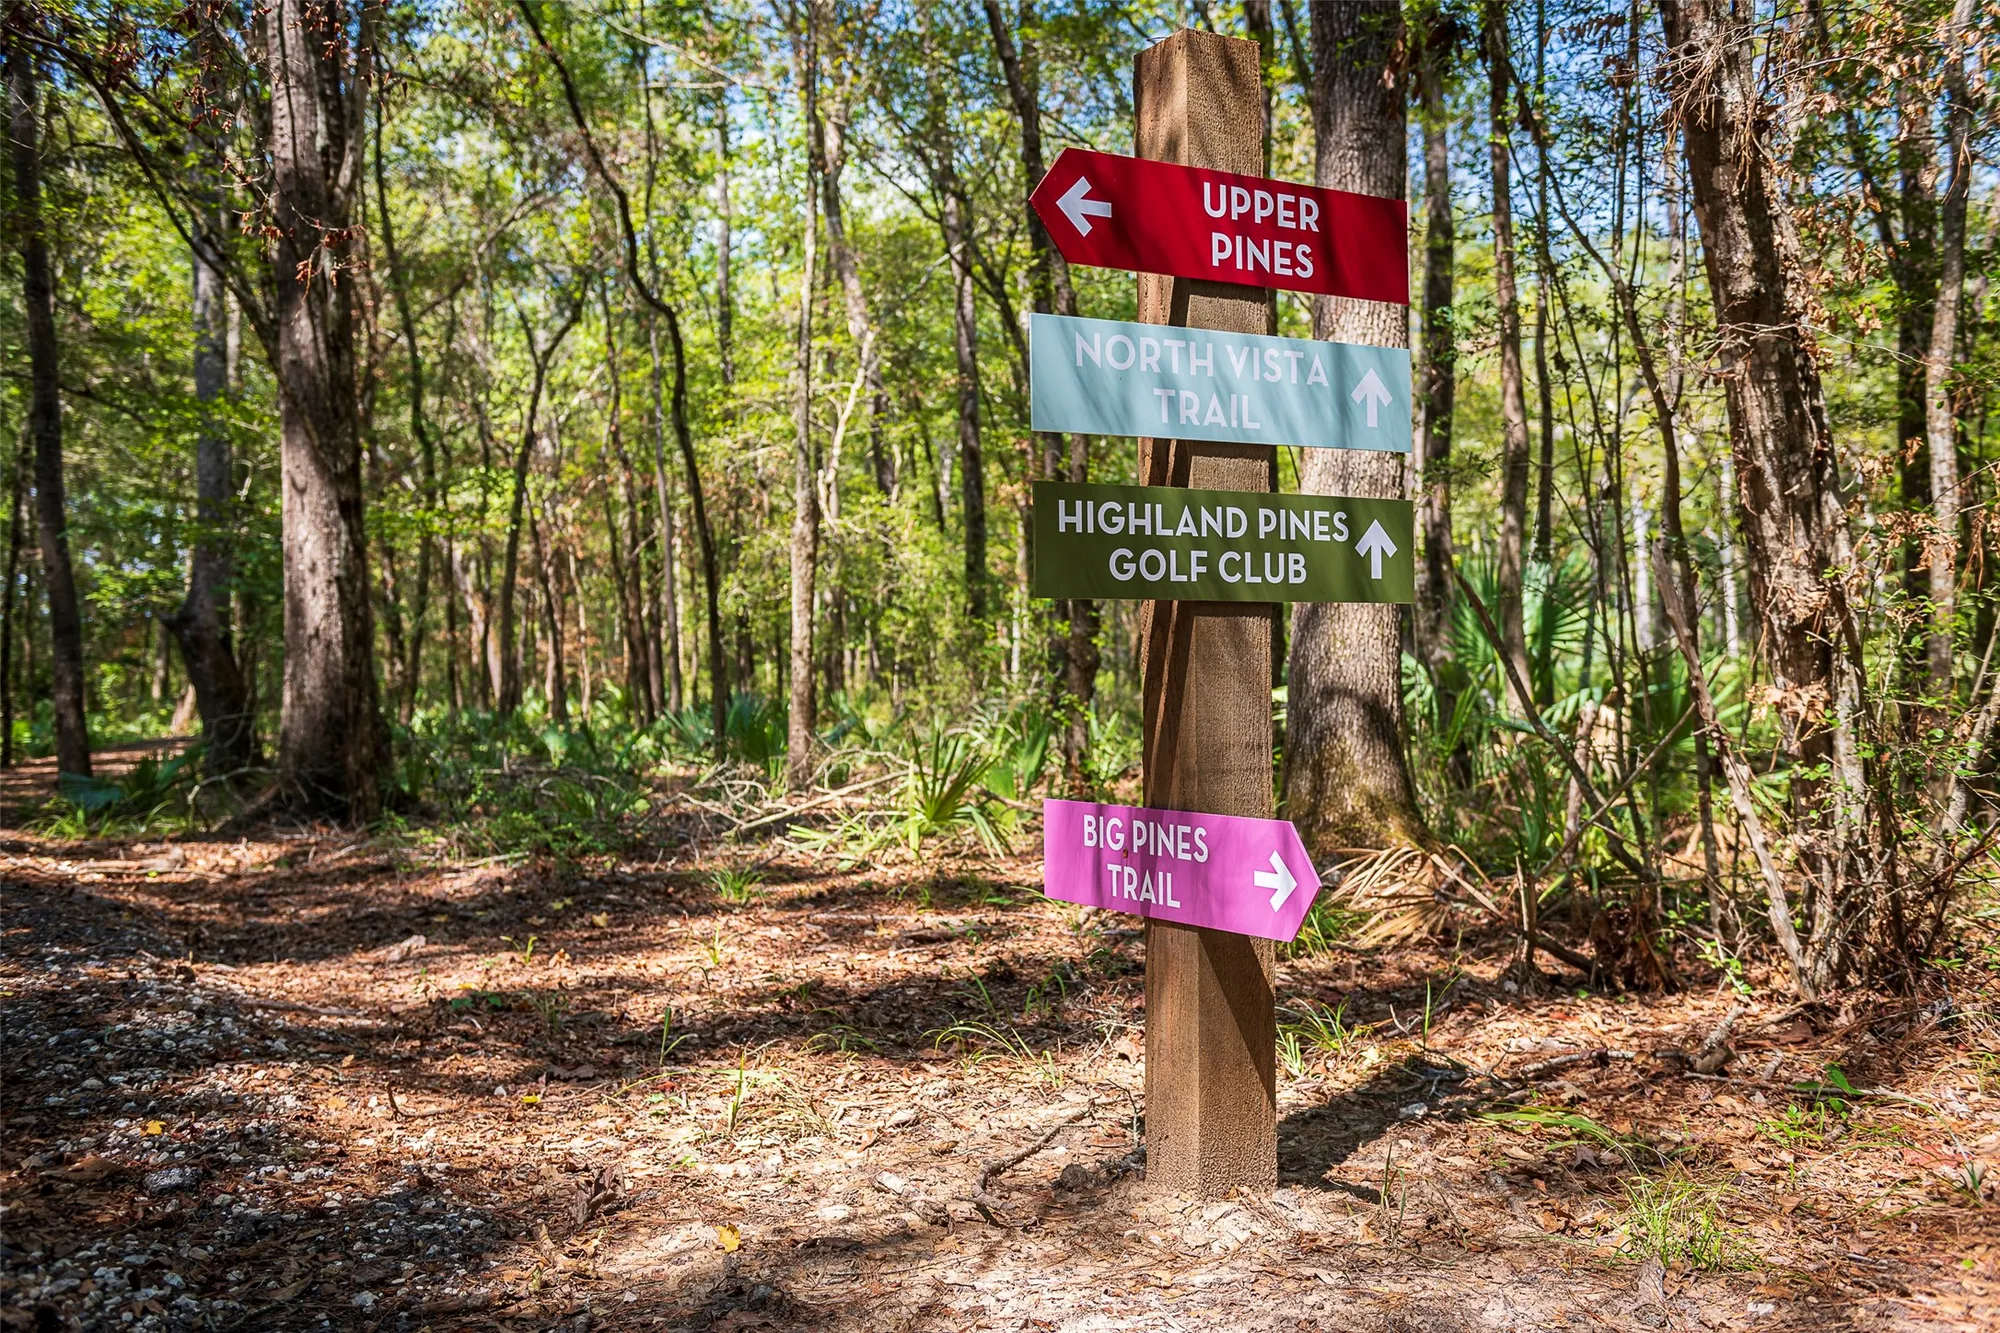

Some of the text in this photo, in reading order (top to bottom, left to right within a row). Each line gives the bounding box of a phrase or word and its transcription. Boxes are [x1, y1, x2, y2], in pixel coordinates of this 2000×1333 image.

[1203, 181, 1320, 233] UPPER
[1211, 231, 1314, 279] PINES
[1075, 329, 1328, 386] NORTH VISTA
[1152, 388, 1261, 431] TRAIL
[1058, 499, 1349, 542] HIGHLAND PINES
[1108, 548, 1307, 584] GOLF CLUB
[1083, 814, 1209, 863] BIG PINES
[1106, 863, 1181, 909] TRAIL
